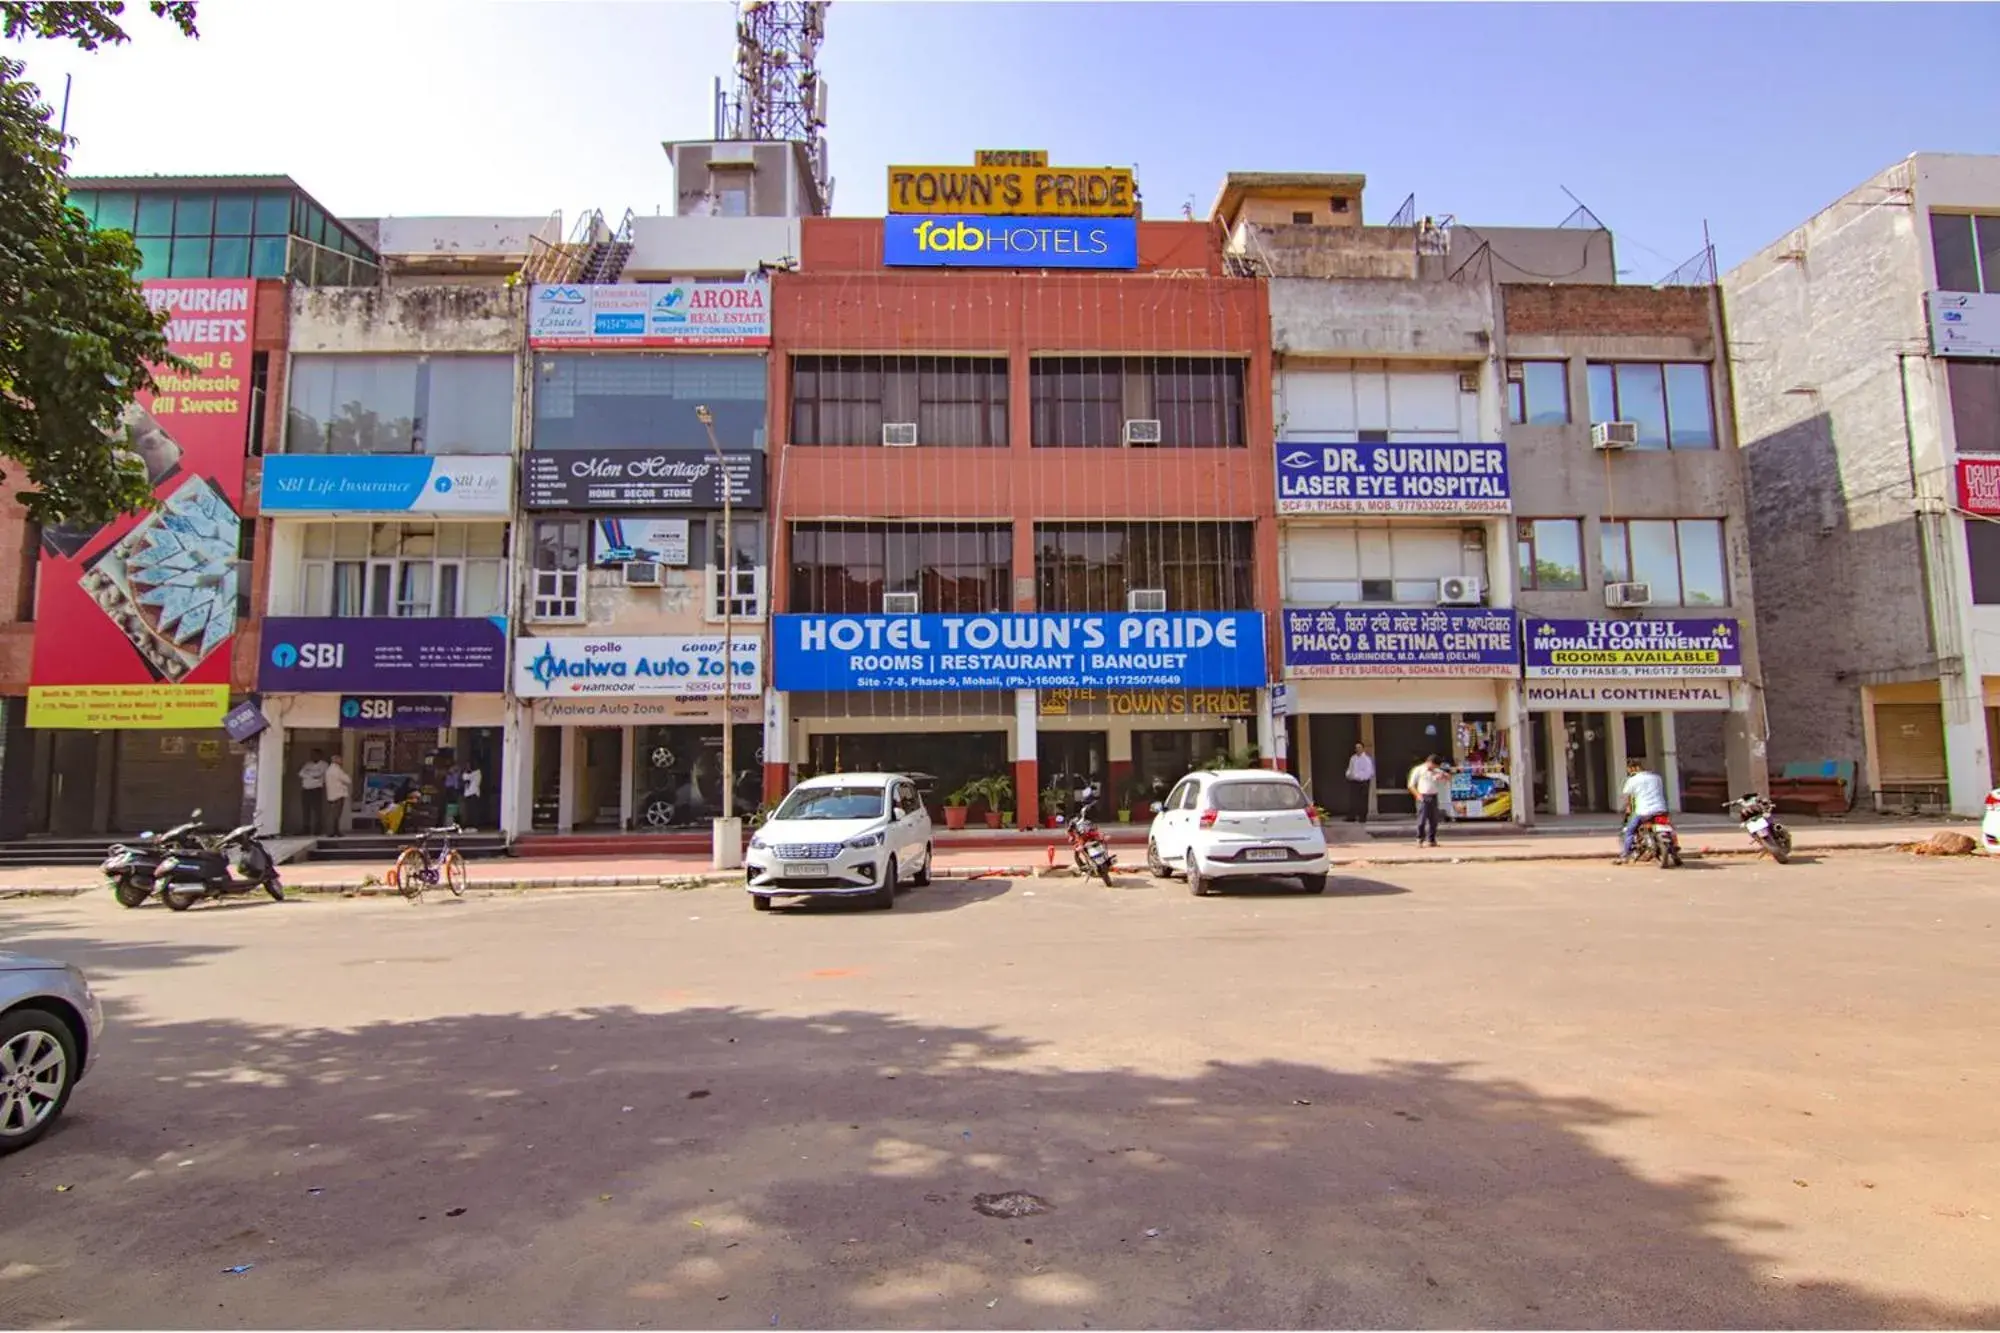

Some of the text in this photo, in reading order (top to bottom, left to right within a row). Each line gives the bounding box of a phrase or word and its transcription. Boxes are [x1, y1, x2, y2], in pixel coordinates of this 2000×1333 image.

[981, 151, 1044, 167] HOTEL
[893, 173, 1128, 207] TOWN'S PRIDE
[689, 289, 763, 308] ARORA
[690, 313, 765, 324] REAL ESTATE
[218, 351, 233, 369] &
[181, 397, 238, 414] Sweets
[1323, 448, 1504, 474] DR. SURINDER
[277, 478, 410, 495] SBI Life Insurance
[588, 488, 693, 498] HOME DECOR STORE
[1282, 476, 1506, 497] LASER EYE HOSPITAL
[1318, 500, 1352, 510] PHASE
[801, 617, 1237, 651] HOTEL TOWN'S PRIDE
[1586, 621, 1683, 638] HOTEL
[584, 642, 622, 655] apollo
[681, 641, 757, 654] GOODEAR
[1292, 633, 1512, 651] PHACO & RETINA CENTRE
[1534, 637, 1733, 650] MOHALI CONTINENTAL
[299, 643, 344, 669] SBI
[850, 655, 924, 671] ROOMS
[941, 654, 1075, 670] RESTAURANT
[1091, 654, 1187, 670] BANQUET
[1446, 651, 1480, 661] (DELHI)
[1556, 652, 1716, 663] ROOMS AVAILABLE
[550, 657, 756, 677] Malwa Auto Zone
[1468, 665, 1512, 675] HOSPITAL
[1540, 667, 1578, 676] SCF-10
[857, 677, 880, 687] Site
[911, 676, 960, 688] Phase-9,
[962, 676, 1003, 687] Mohali,
[1053, 687, 1097, 700] HOTEL
[1528, 689, 1722, 700] MOHALI CONTINENTAL
[360, 699, 394, 719] SBI
[550, 703, 597, 715] Malwa
[600, 703, 630, 715] Auto
[633, 703, 664, 715] Zone
[1106, 693, 1252, 714] TOWN'S PRIDE
